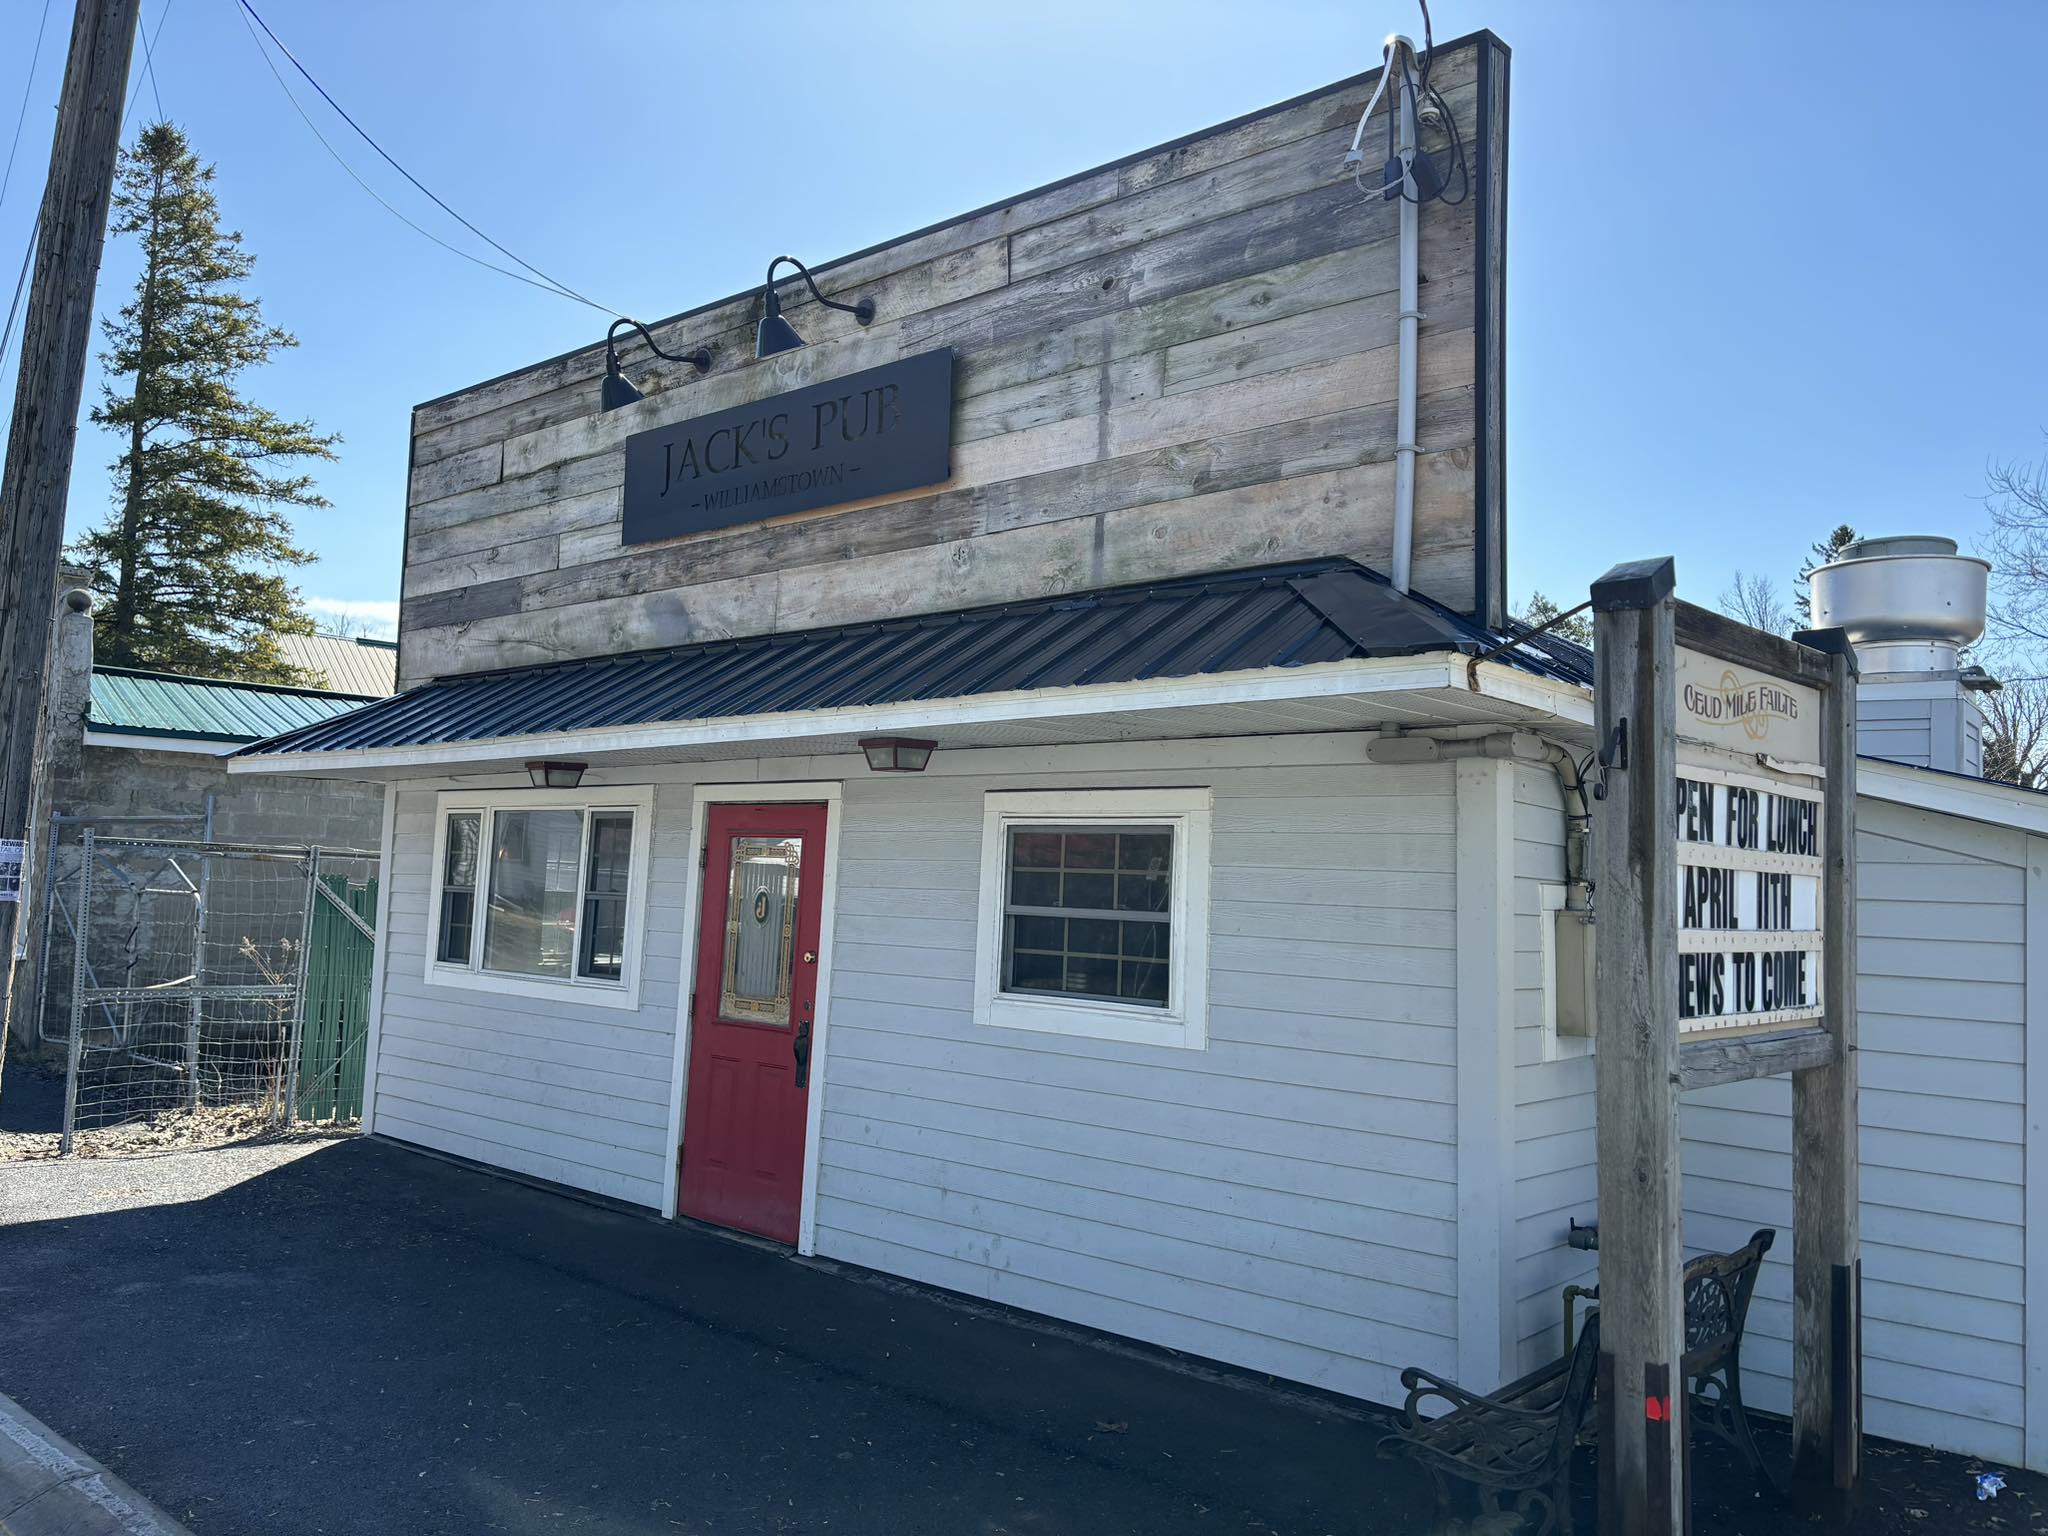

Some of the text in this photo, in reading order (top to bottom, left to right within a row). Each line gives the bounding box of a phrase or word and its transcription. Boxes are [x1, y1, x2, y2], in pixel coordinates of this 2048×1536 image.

[660, 383, 901, 497] JACK'S PUB
[1684, 684, 1798, 720] CEUD MILE FAILTE
[1676, 777, 1818, 857] PEN FOR LUNCH
[1684, 865, 1738, 929] APRIL
[1732, 952, 1755, 1012] TO
[1762, 951, 1806, 1011] COME
